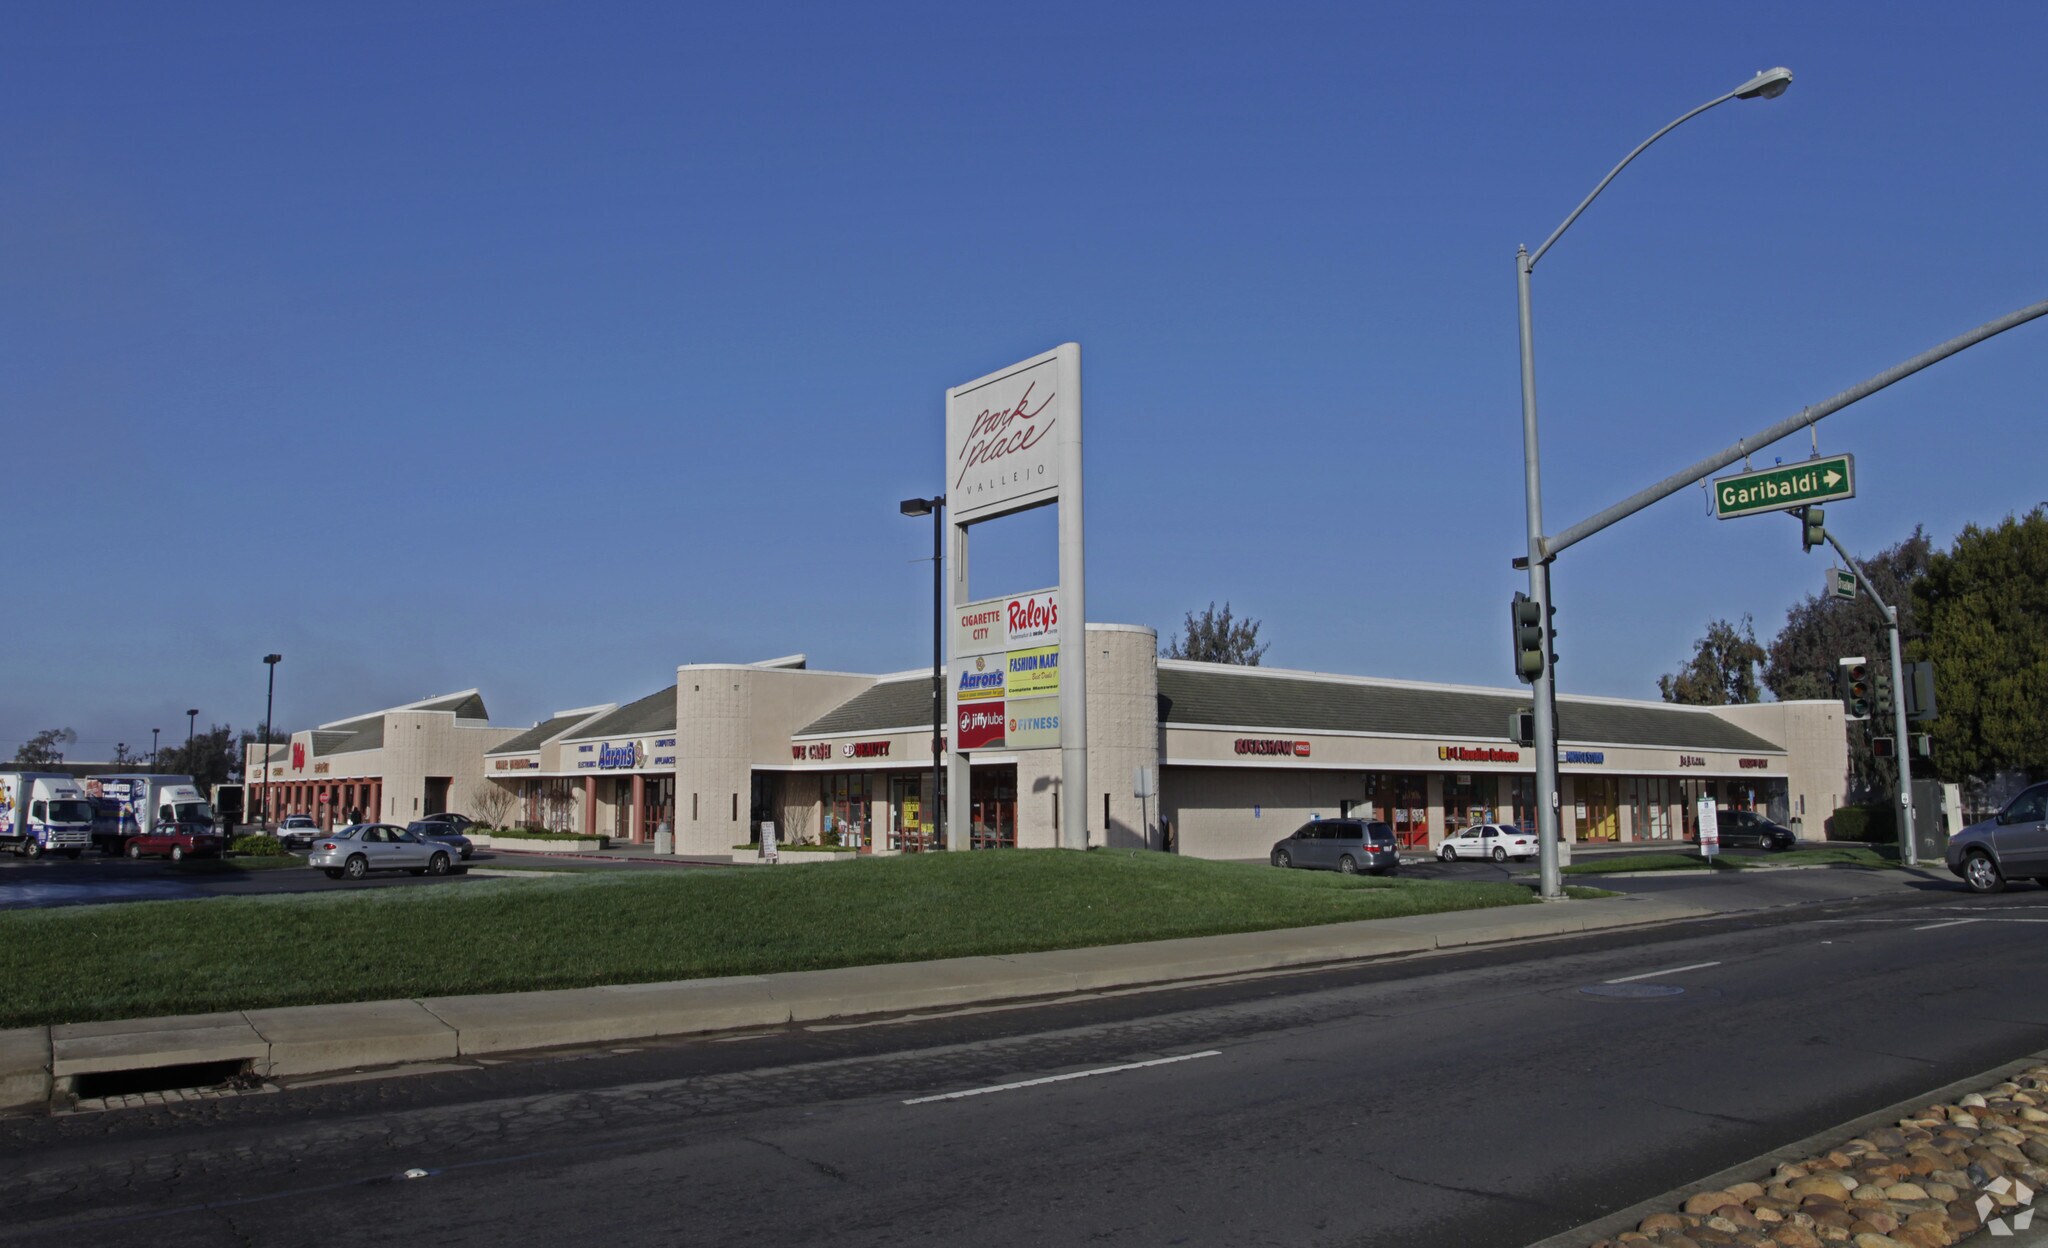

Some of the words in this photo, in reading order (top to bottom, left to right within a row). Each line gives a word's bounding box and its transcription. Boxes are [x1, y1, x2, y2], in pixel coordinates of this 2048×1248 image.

[967, 464, 1044, 495] VALLEJO
[1722, 472, 1818, 506] Garibaldi
[961, 611, 1000, 627] CIGARETTE
[1007, 597, 1057, 634] Raley's
[973, 628, 989, 640] CITY
[1009, 656, 1038, 672] FASHION
[1039, 653, 1059, 669] MART
[959, 669, 1004, 690] Aaron's
[1018, 717, 1059, 731] FITNESS
[599, 741, 635, 769] Aaron's
[792, 745, 806, 760] WE
[855, 741, 890, 758] BEAUTY
[1234, 738, 1293, 756] RICKSHAW
